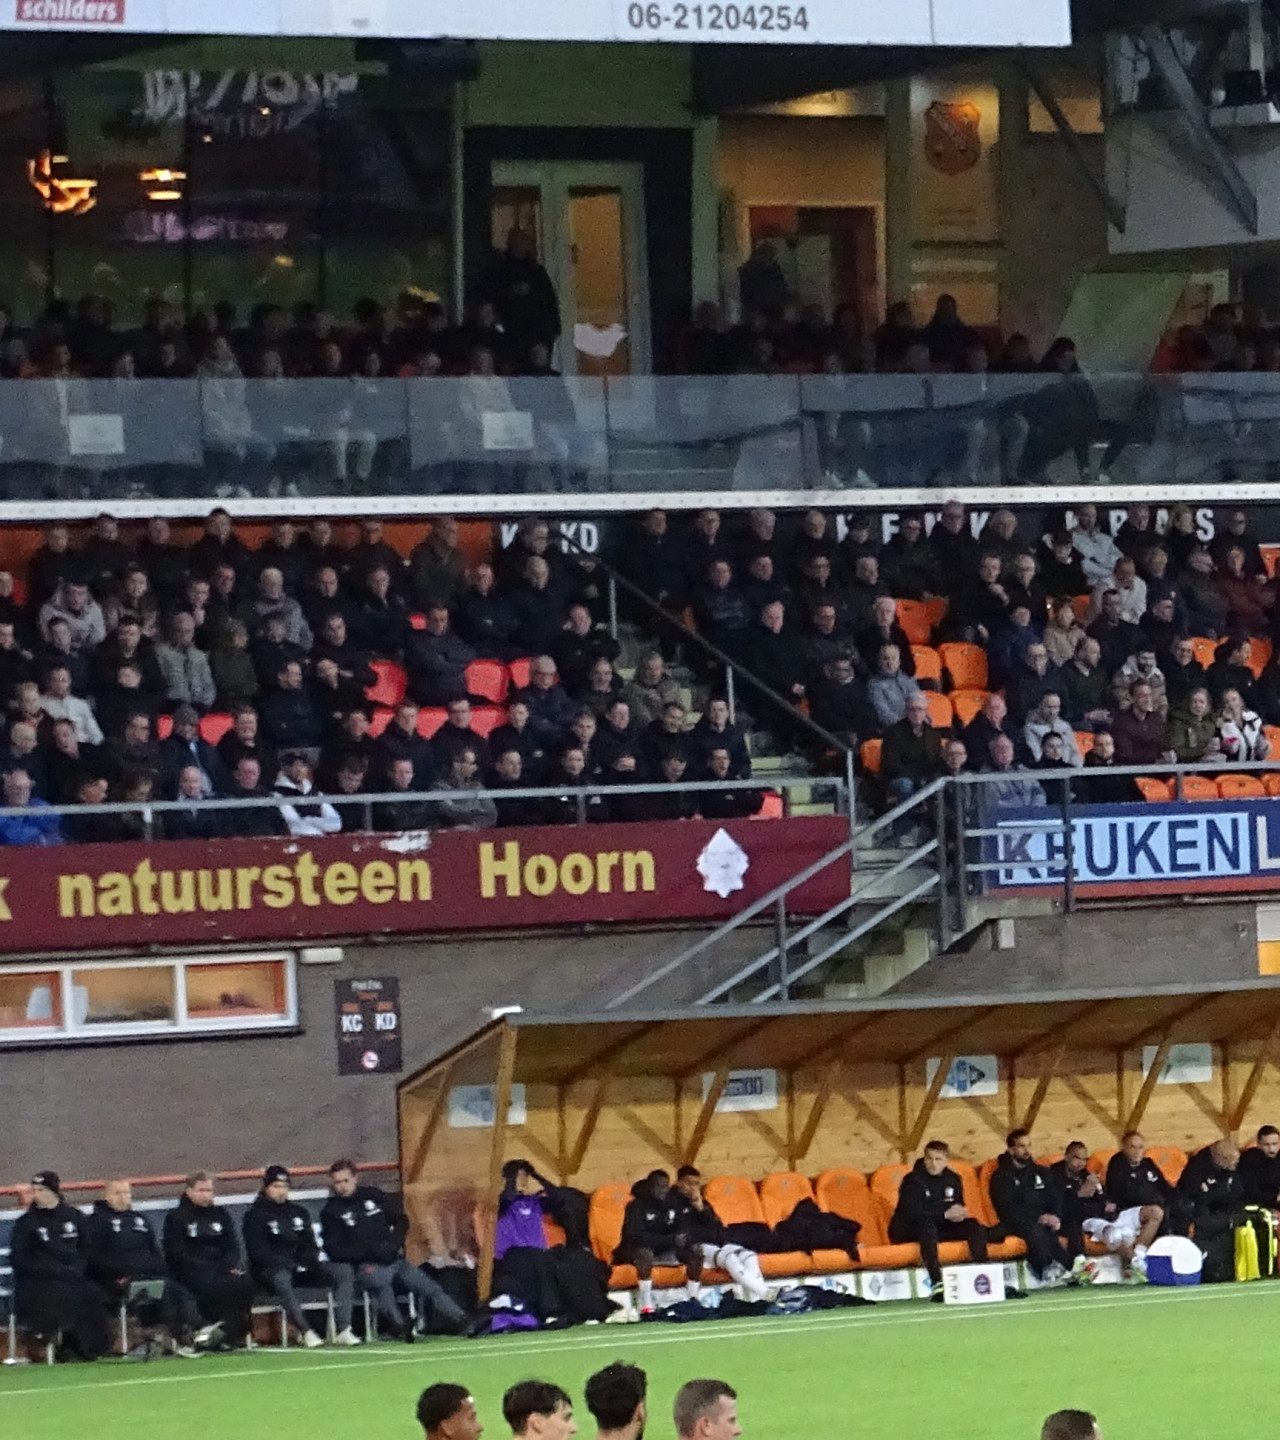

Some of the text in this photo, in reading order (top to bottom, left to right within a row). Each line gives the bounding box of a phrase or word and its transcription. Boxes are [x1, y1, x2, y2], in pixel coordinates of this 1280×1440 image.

[627, 3, 809, 31] 06-21204254
[58, 854, 432, 917] natuursteen
[479, 840, 656, 897] Hoorn
